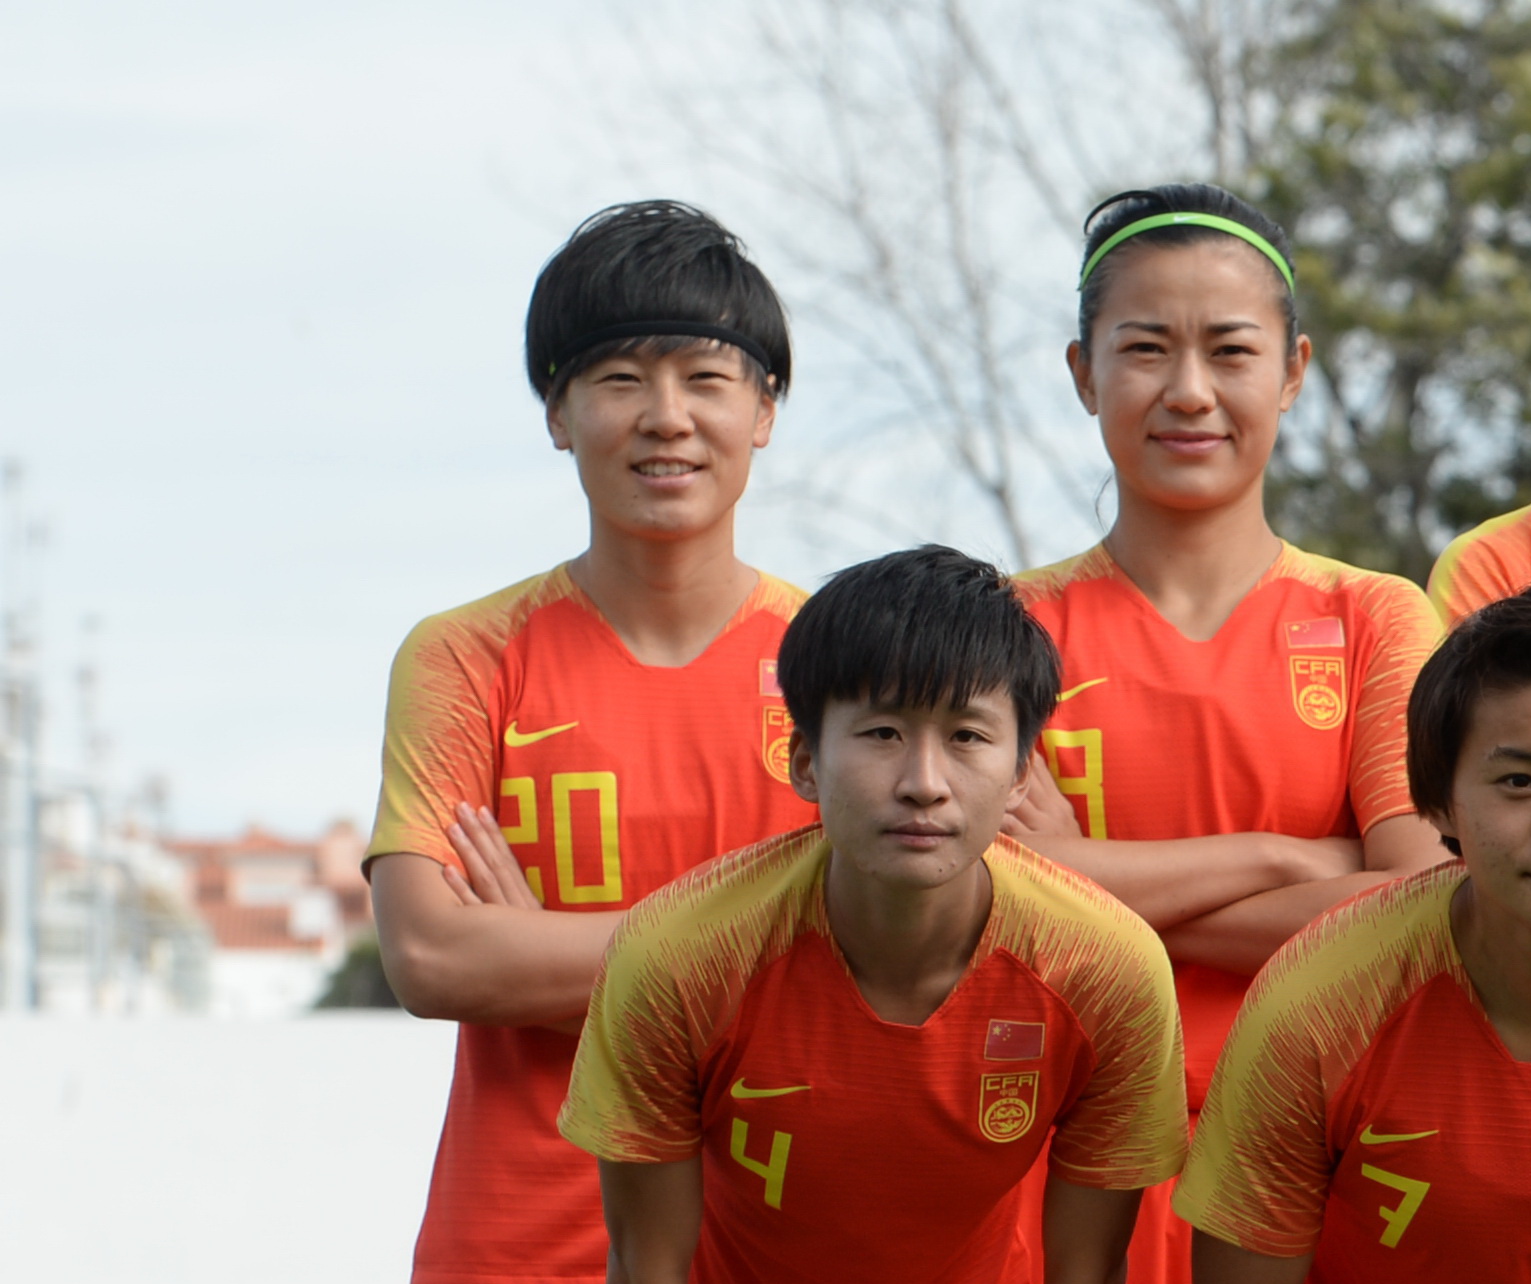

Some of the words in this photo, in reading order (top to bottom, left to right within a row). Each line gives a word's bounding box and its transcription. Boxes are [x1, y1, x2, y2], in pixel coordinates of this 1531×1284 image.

[1295, 661, 1340, 677] CFA
[500, 771, 623, 905] 20
[986, 1075, 1033, 1091] CFA
[730, 1117, 792, 1211] 4
[1361, 1162, 1431, 1249] 7
